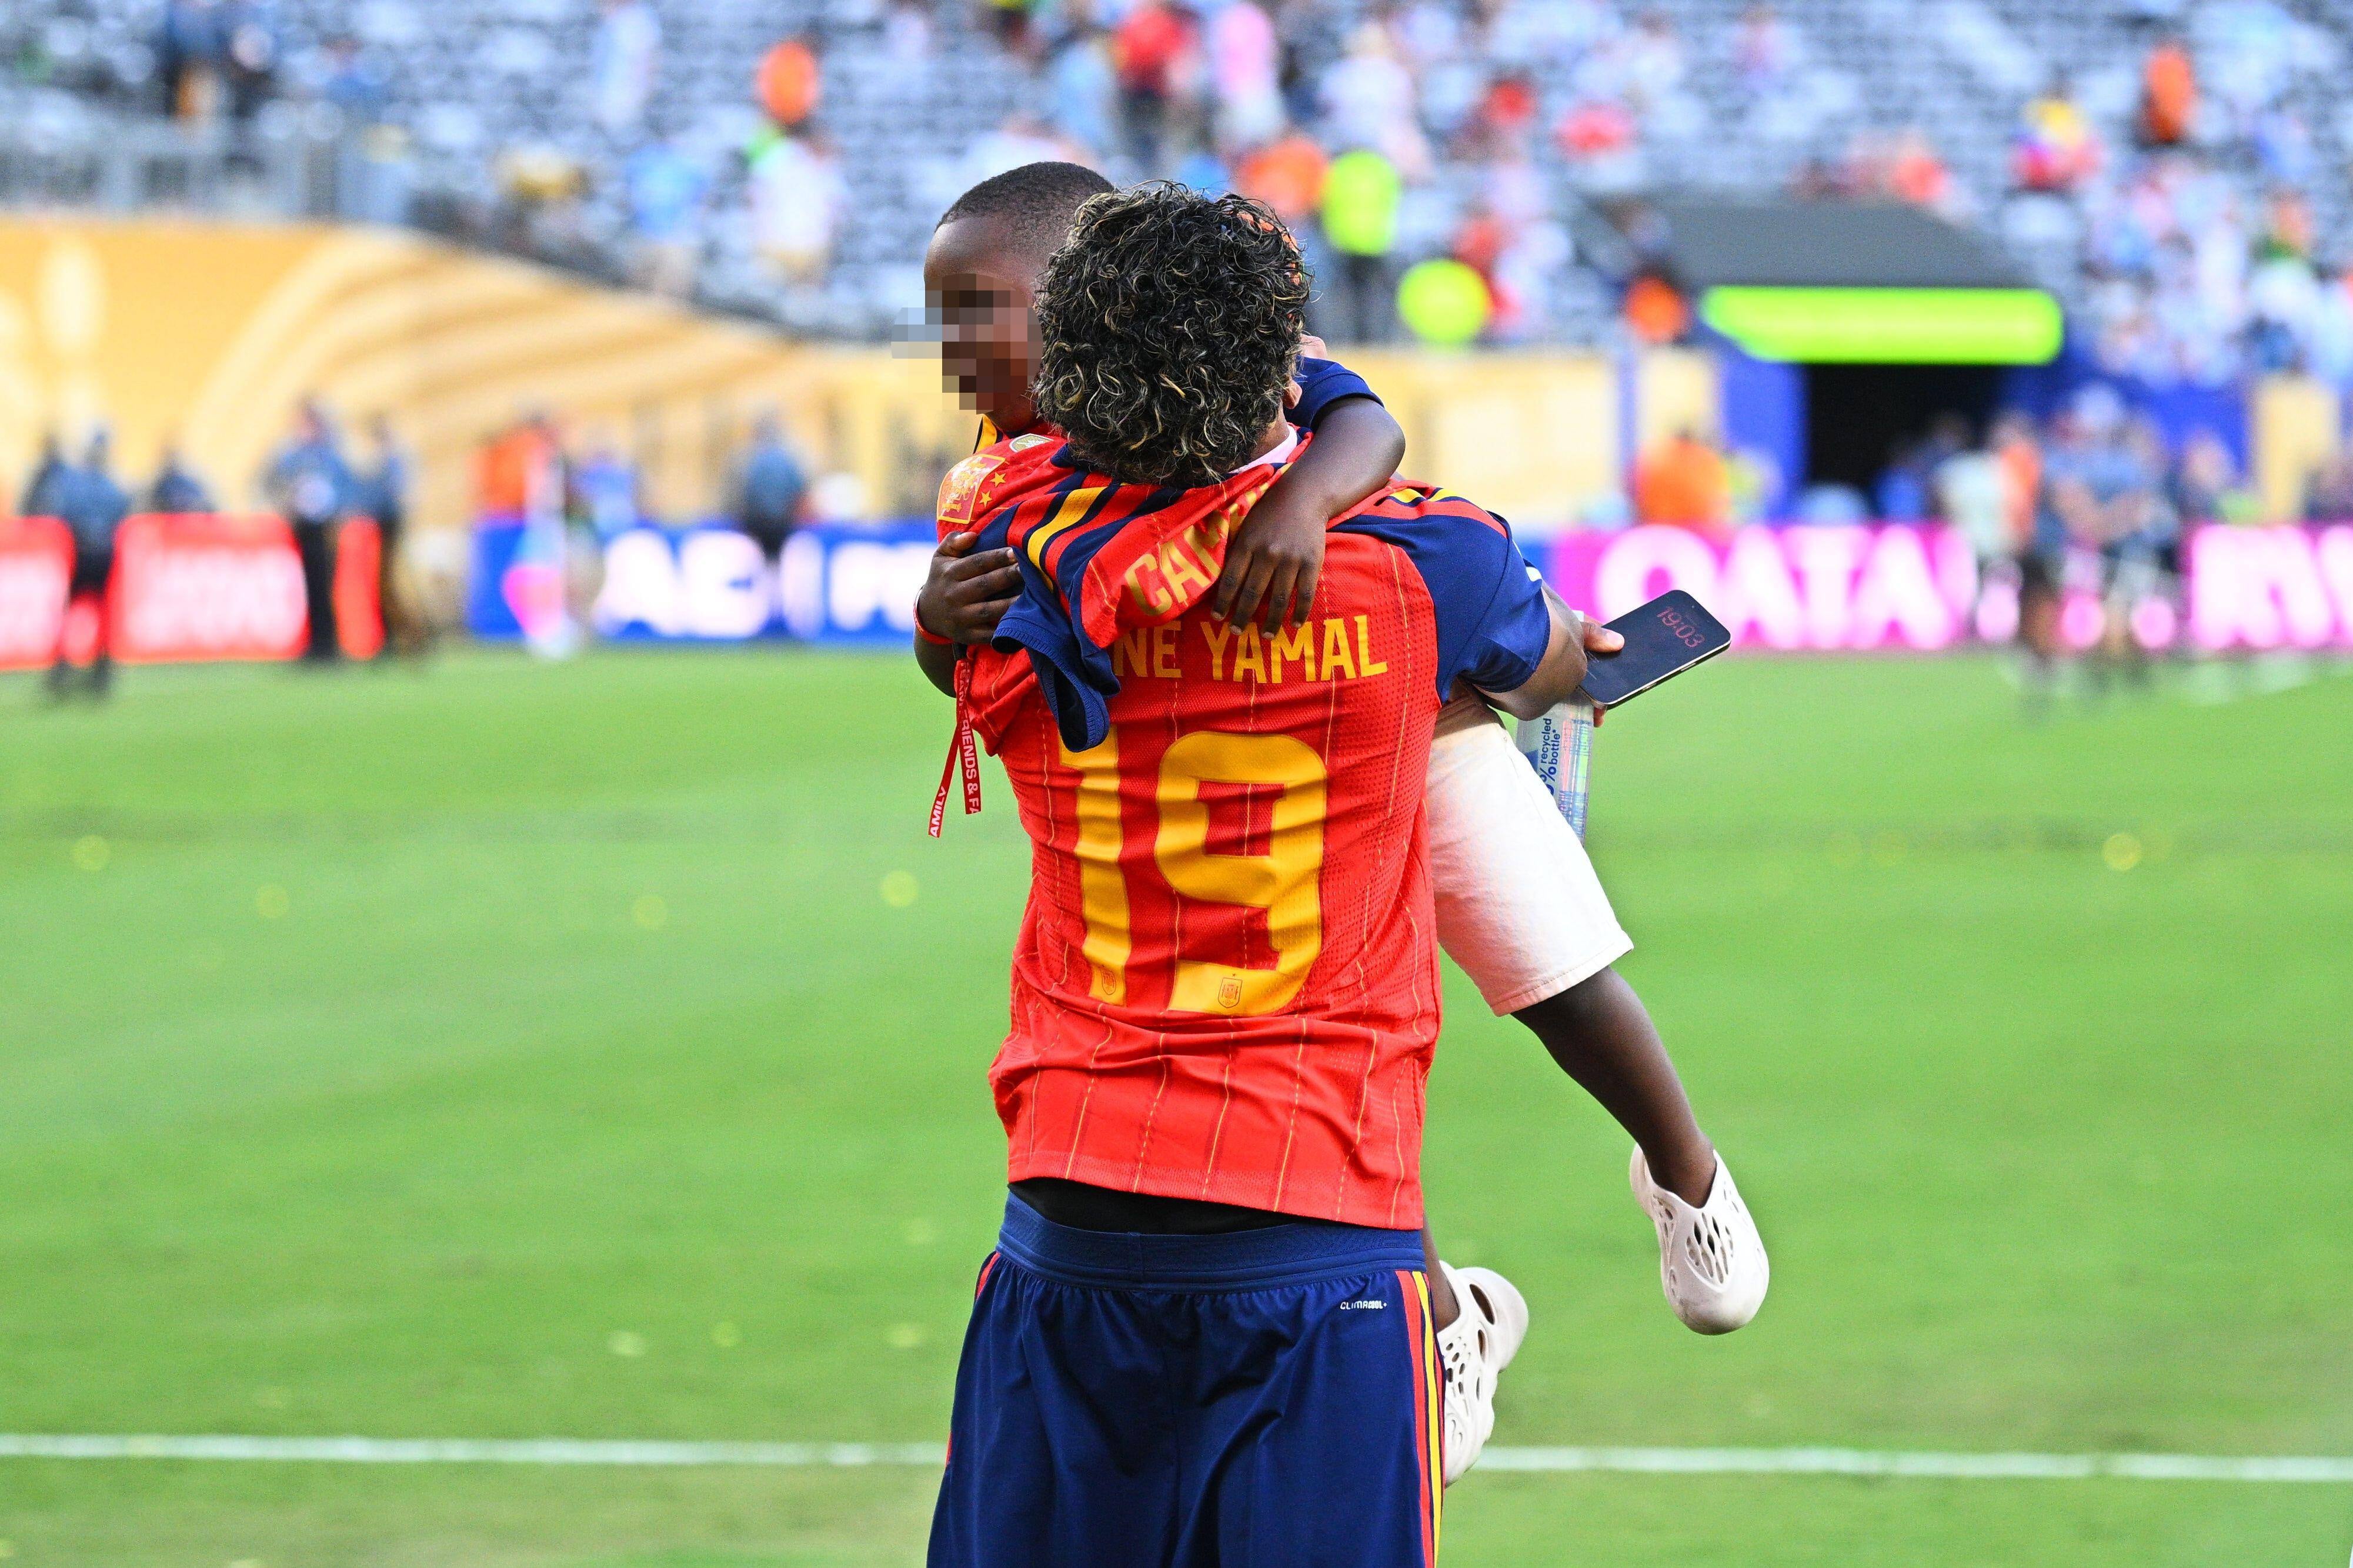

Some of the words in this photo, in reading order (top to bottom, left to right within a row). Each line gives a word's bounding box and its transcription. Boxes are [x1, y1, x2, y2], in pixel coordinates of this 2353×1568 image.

[1200, 614, 1389, 684] YAMAL
[1656, 606, 1705, 648] 19:03
[1540, 718, 1552, 764] recycled
[966, 782, 978, 795] &
[1059, 724, 1327, 1017] 19
